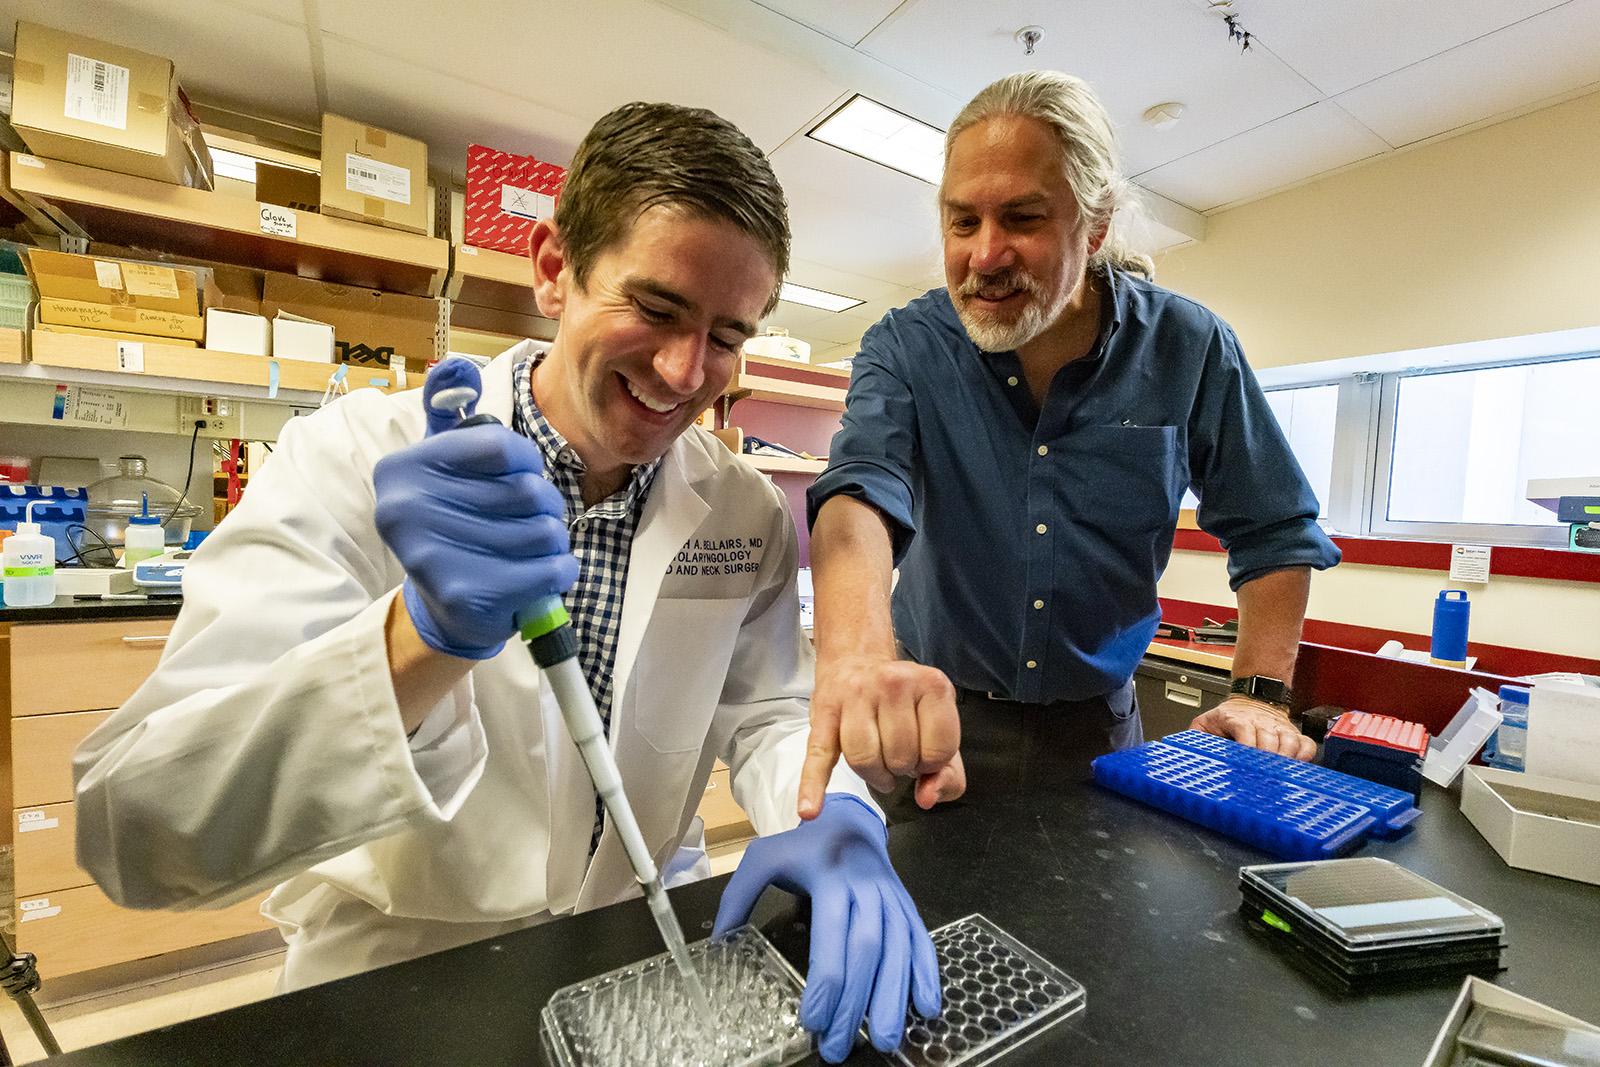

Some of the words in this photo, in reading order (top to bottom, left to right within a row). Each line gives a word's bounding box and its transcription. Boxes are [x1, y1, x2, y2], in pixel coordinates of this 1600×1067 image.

[261, 208, 286, 222] Glove
[335, 341, 395, 366] DEL
[703, 538, 746, 551] BELLAIRS,
[749, 538, 763, 548] MD
[673, 551, 751, 563] OLARYNGOLOGY
[676, 565, 698, 576] AND
[701, 565, 720, 576] NECK
[724, 562, 760, 574] SURGER
